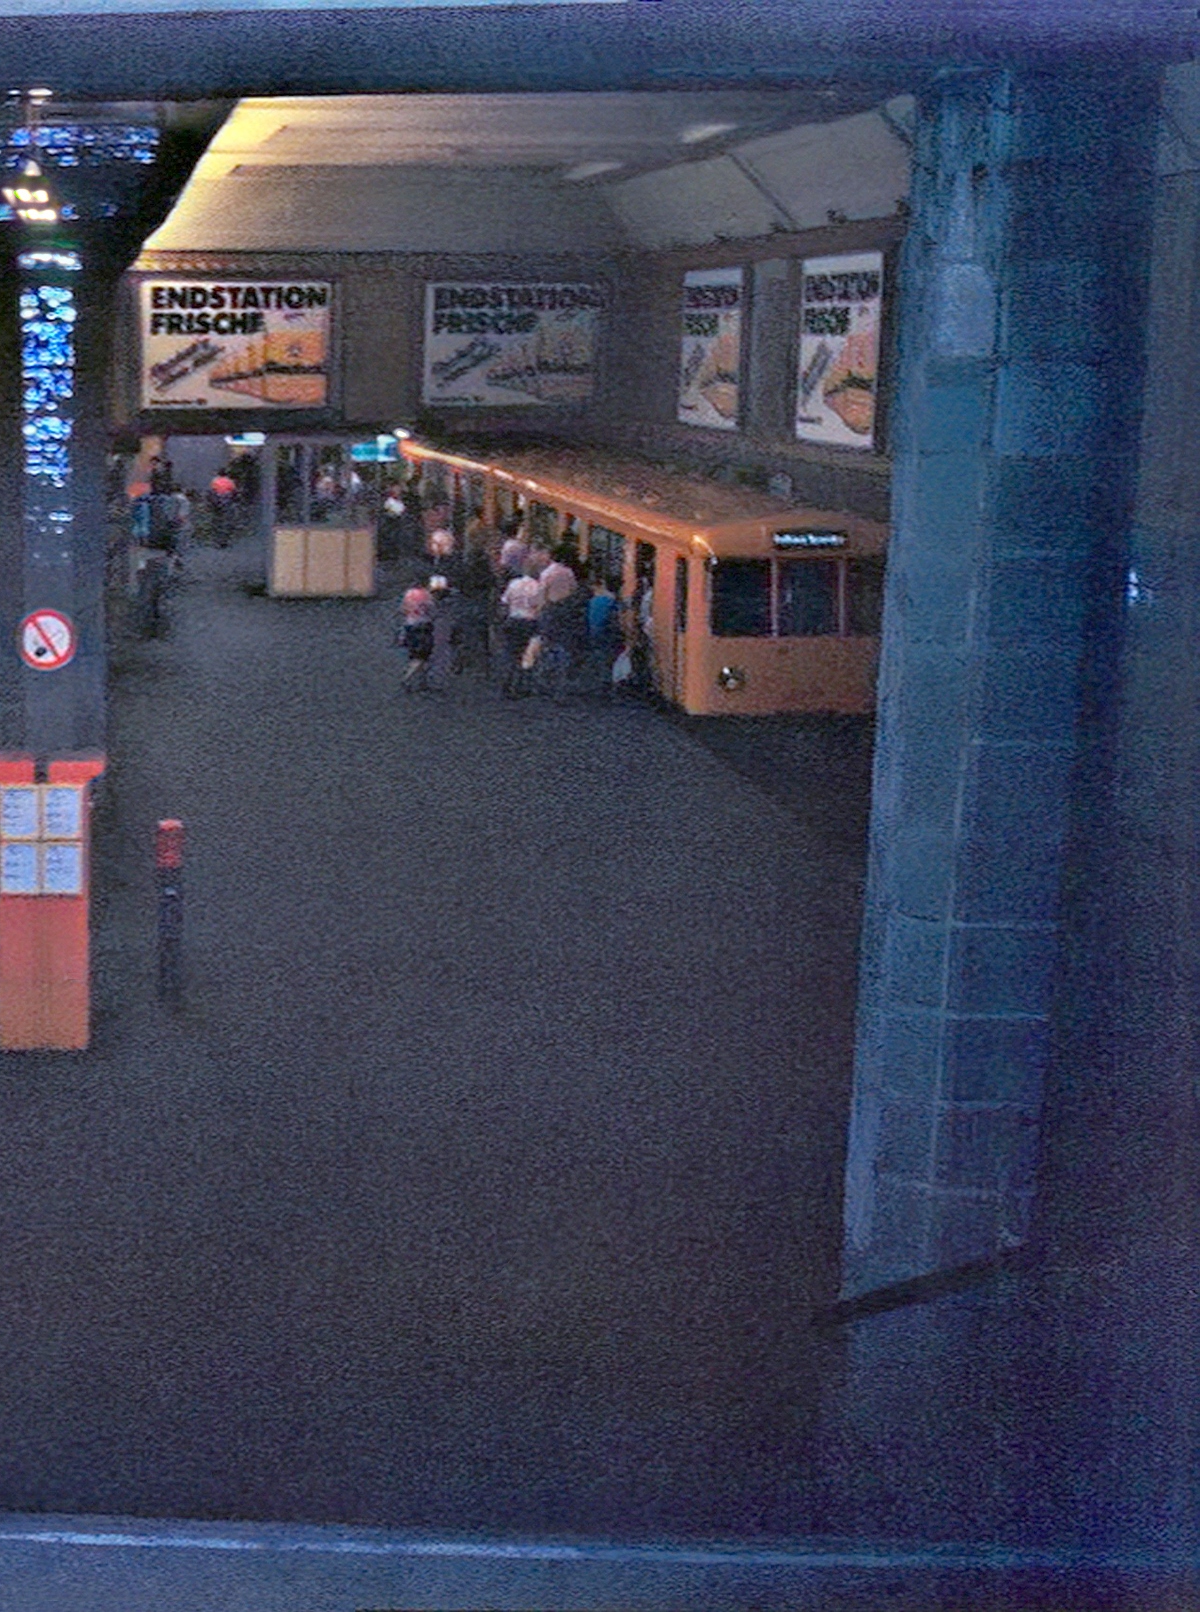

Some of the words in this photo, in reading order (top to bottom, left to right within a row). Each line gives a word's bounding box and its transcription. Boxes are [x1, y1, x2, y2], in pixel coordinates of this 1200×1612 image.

[150, 286, 328, 310] ENDSTATION
[433, 286, 606, 310] ENDSTATION
[150, 312, 266, 336] FRISCHE
